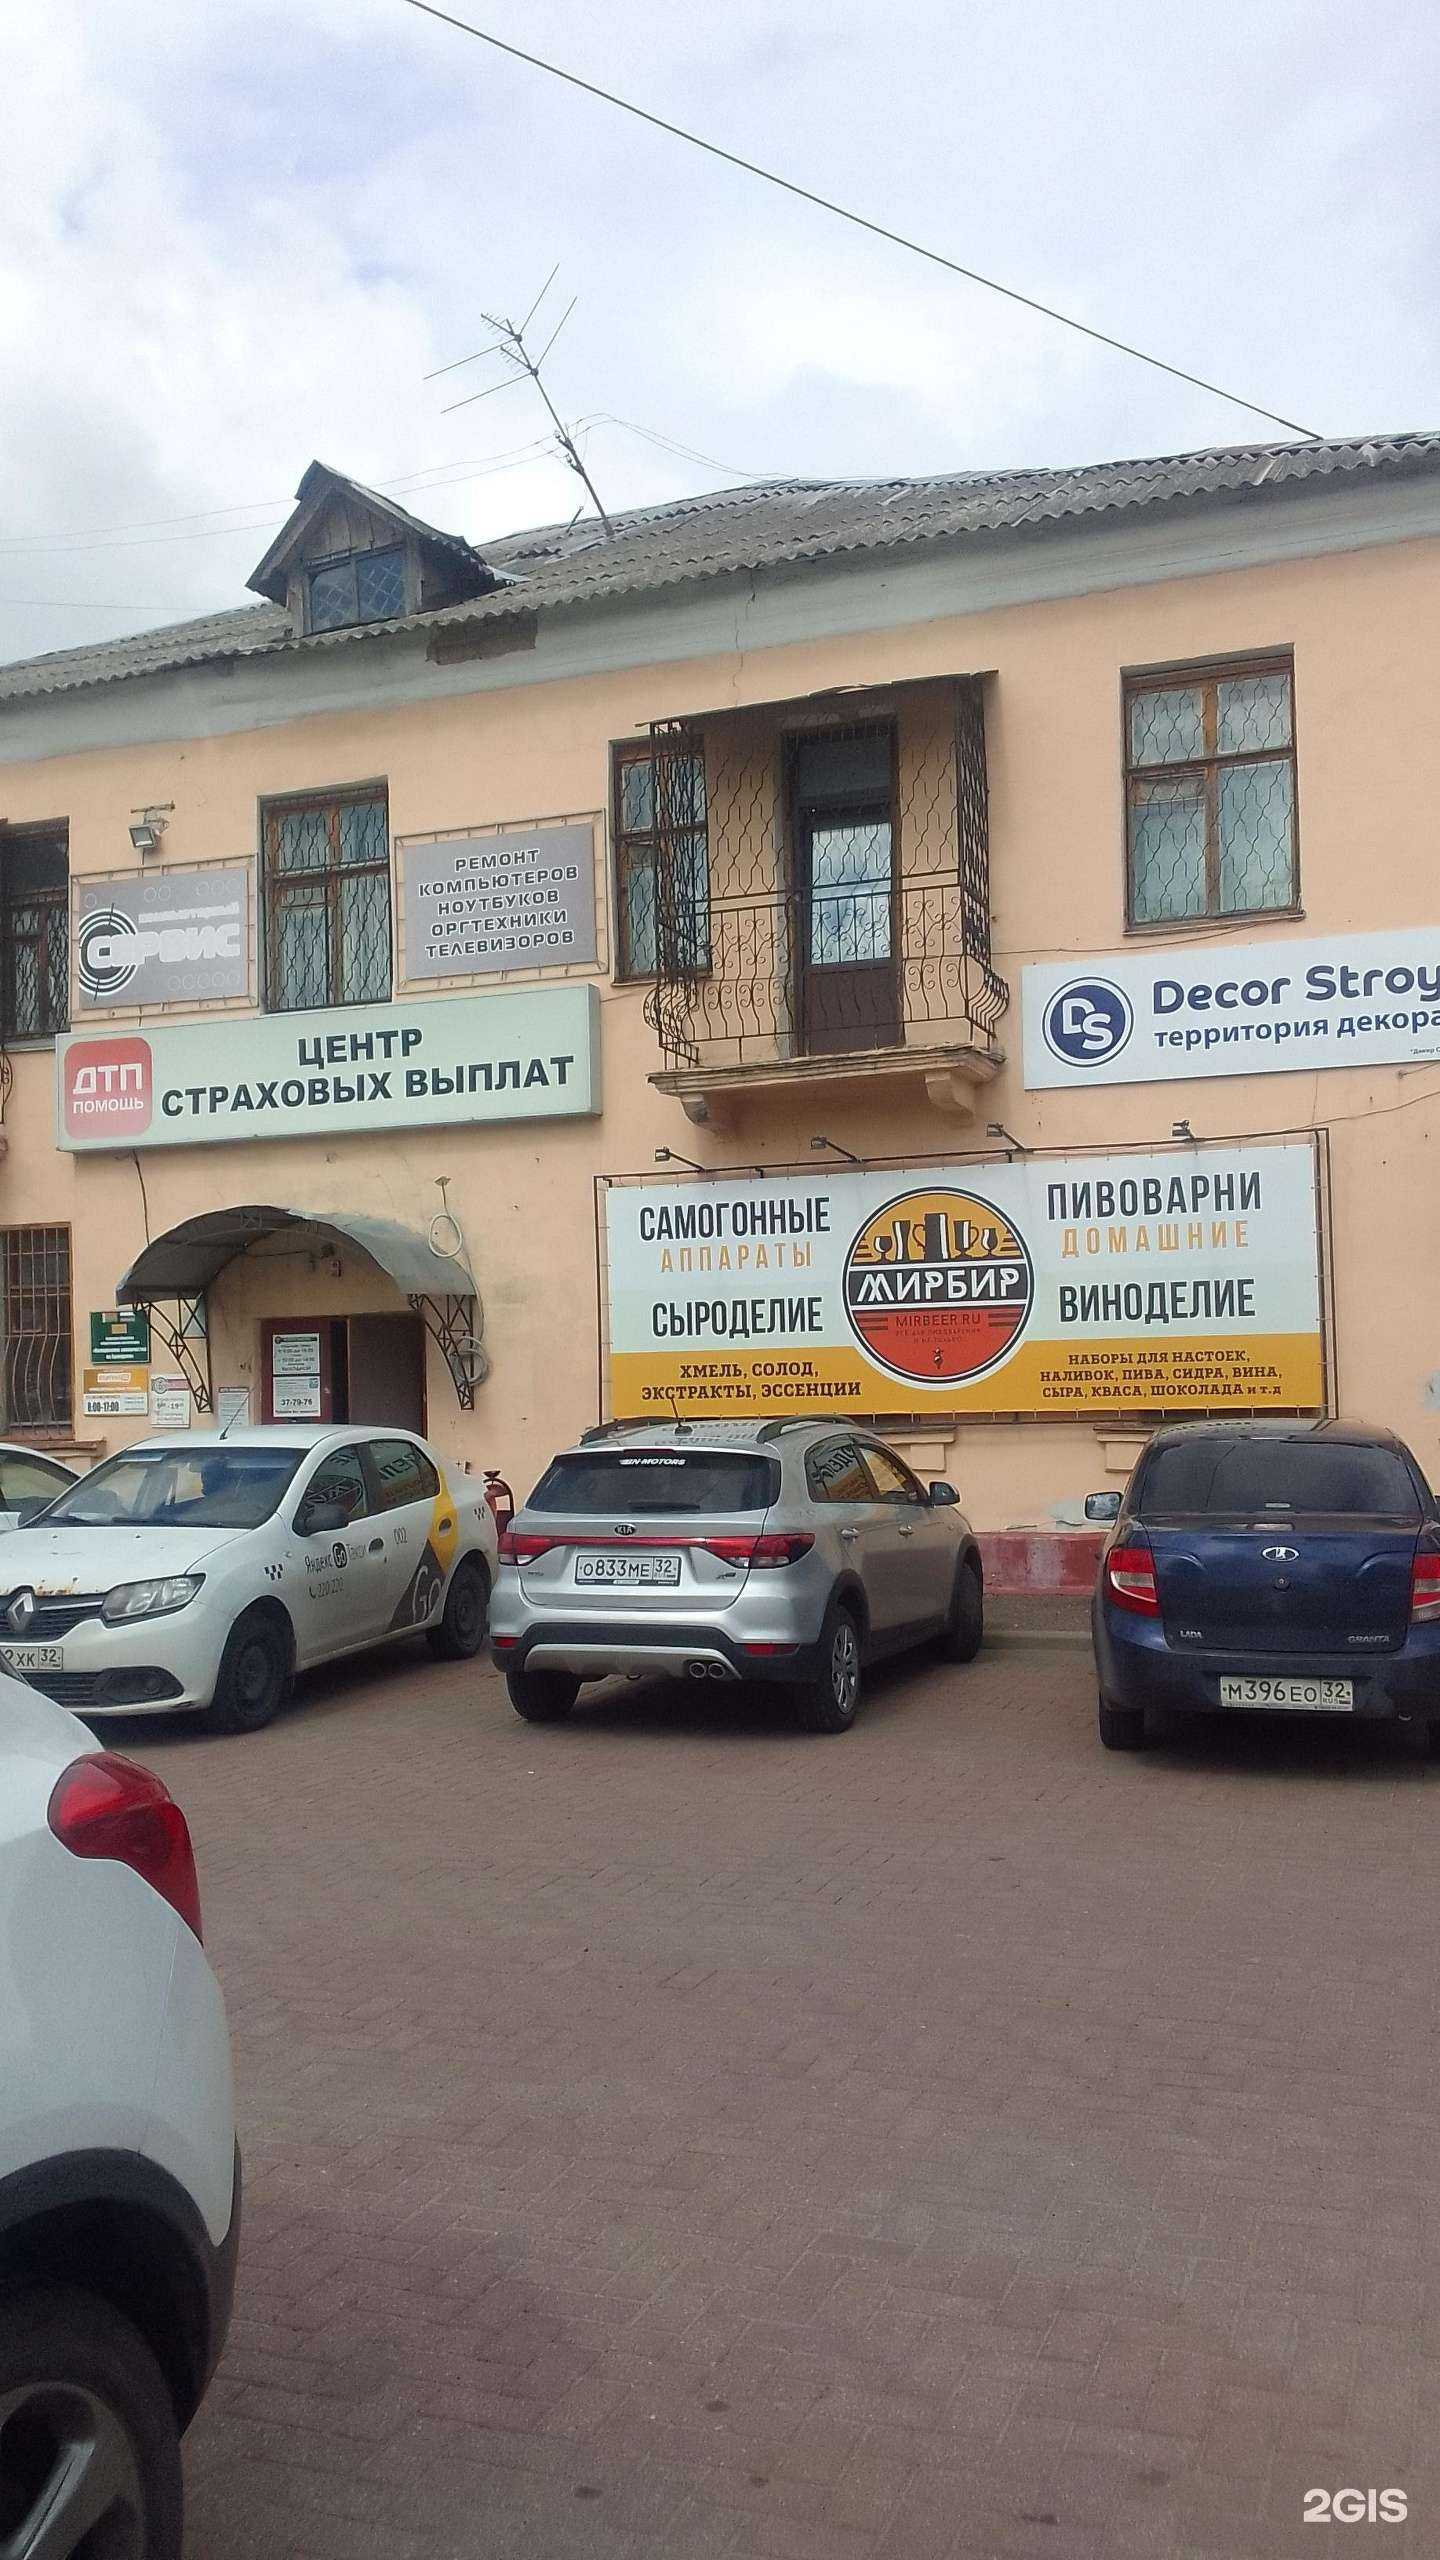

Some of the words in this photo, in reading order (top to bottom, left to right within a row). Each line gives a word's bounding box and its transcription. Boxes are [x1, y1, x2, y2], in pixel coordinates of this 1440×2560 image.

[455, 849, 539, 872] РЕМОНТ
[419, 866, 578, 897] КОМПЬЮТЕРОВ
[438, 890, 559, 915] НОУТБУКОВ
[431, 910, 567, 936] ОРГТЕХНИКИ
[426, 931, 574, 958] ТЕЛЕВИЗОРОВ
[1153, 977, 1291, 1014] Decor
[1305, 965, 1440, 1002] Stroy
[1154, 1019, 1329, 1050] территория
[298, 1028, 423, 1069] ЦЕНТР
[73, 1063, 143, 1094] ДТП
[161, 1072, 392, 1117] СТРАХОВЫХ
[405, 1055, 574, 1098] ВЫПЛАТ
[73, 1097, 144, 1114] ПОМОЩЬ
[1047, 1172, 1261, 1220] ПИВОВАРНИ
[639, 1197, 831, 1241] САМОГОННЫЕ
[1061, 1220, 1249, 1258] ДОМАШНИЕ
[661, 1241, 811, 1273] АППАРАТЫ
[857, 1268, 1020, 1302] МИРБИР
[1059, 1279, 1255, 1324] ВИНОДЕЛИЕ
[652, 1297, 823, 1339] СЫРОДЕЛИЕ
[680, 1364, 747, 1379] ХМЕЛЬ,
[752, 1361, 819, 1377] СОЛОД,
[1068, 1353, 1133, 1365] НАБОРЫ
[1137, 1351, 1168, 1364] ДЛЯ
[1172, 1350, 1250, 1363] НАСТОЕК,
[1040, 1369, 1118, 1383] НАЛИВОК,
[1122, 1368, 1169, 1382] ПИВА,
[1172, 1367, 1229, 1381] СИДРА,
[1232, 1365, 1282, 1379] ВИНА,
[642, 1384, 757, 1400] ЭКСТРАКТЫ,
[761, 1381, 861, 1398] ЭССЕНЦИИ
[1042, 1386, 1088, 1399] СЫРА,
[1091, 1385, 1147, 1398] КВАСА,
[1150, 1384, 1243, 1397] ШОКОЛАДА
[615, 1526, 635, 1535] KIA
[583, 1559, 649, 1577] О833МЕ
[655, 1559, 672, 1573] 32
[1179, 1630, 1202, 1639] LADA
[41, 1648, 57, 1662] 32
[1228, 1680, 1317, 1703] М396ЕО
[1323, 1682, 1345, 1698] 32
